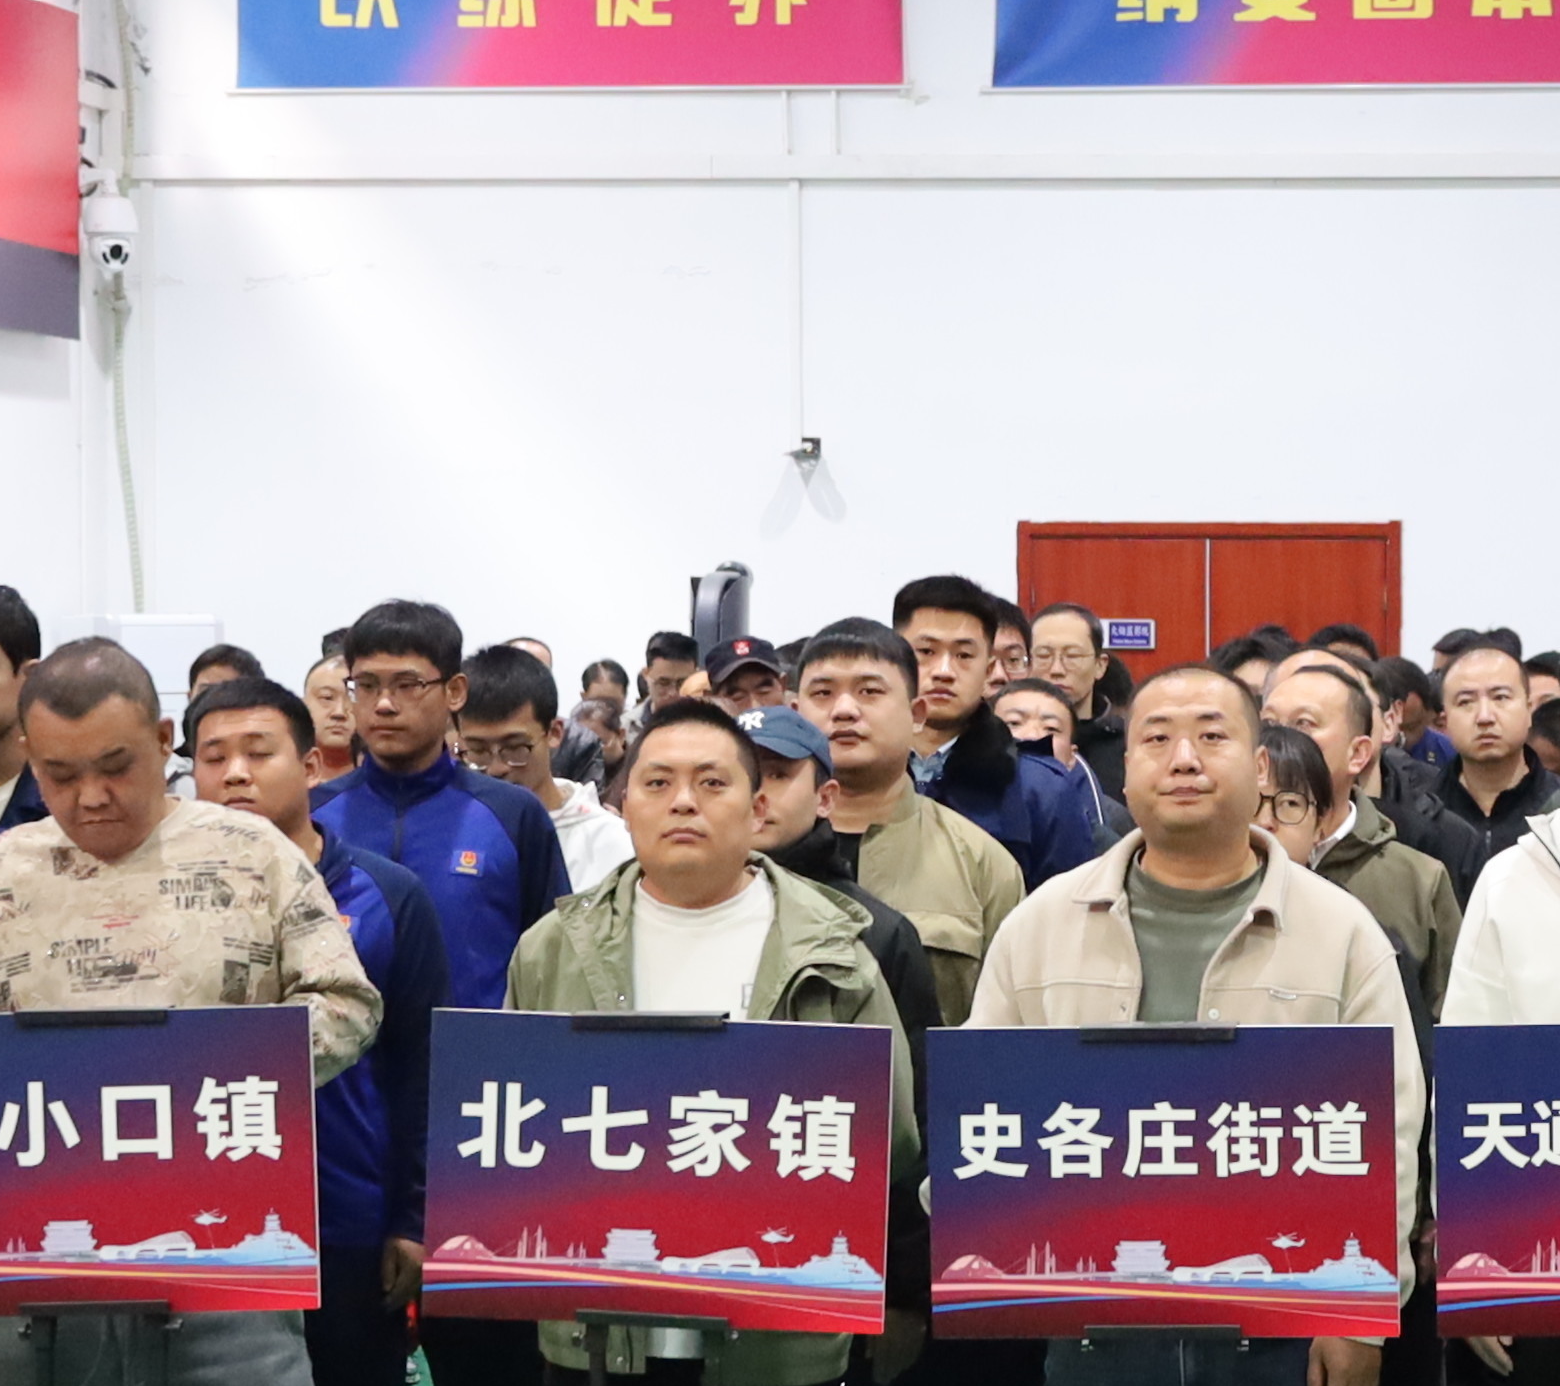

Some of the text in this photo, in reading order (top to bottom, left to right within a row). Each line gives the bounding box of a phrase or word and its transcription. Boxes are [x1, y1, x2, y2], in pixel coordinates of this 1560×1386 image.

[458, 1082, 855, 1182] 北七家镇
[954, 1102, 1369, 1179] 史各庄街道
